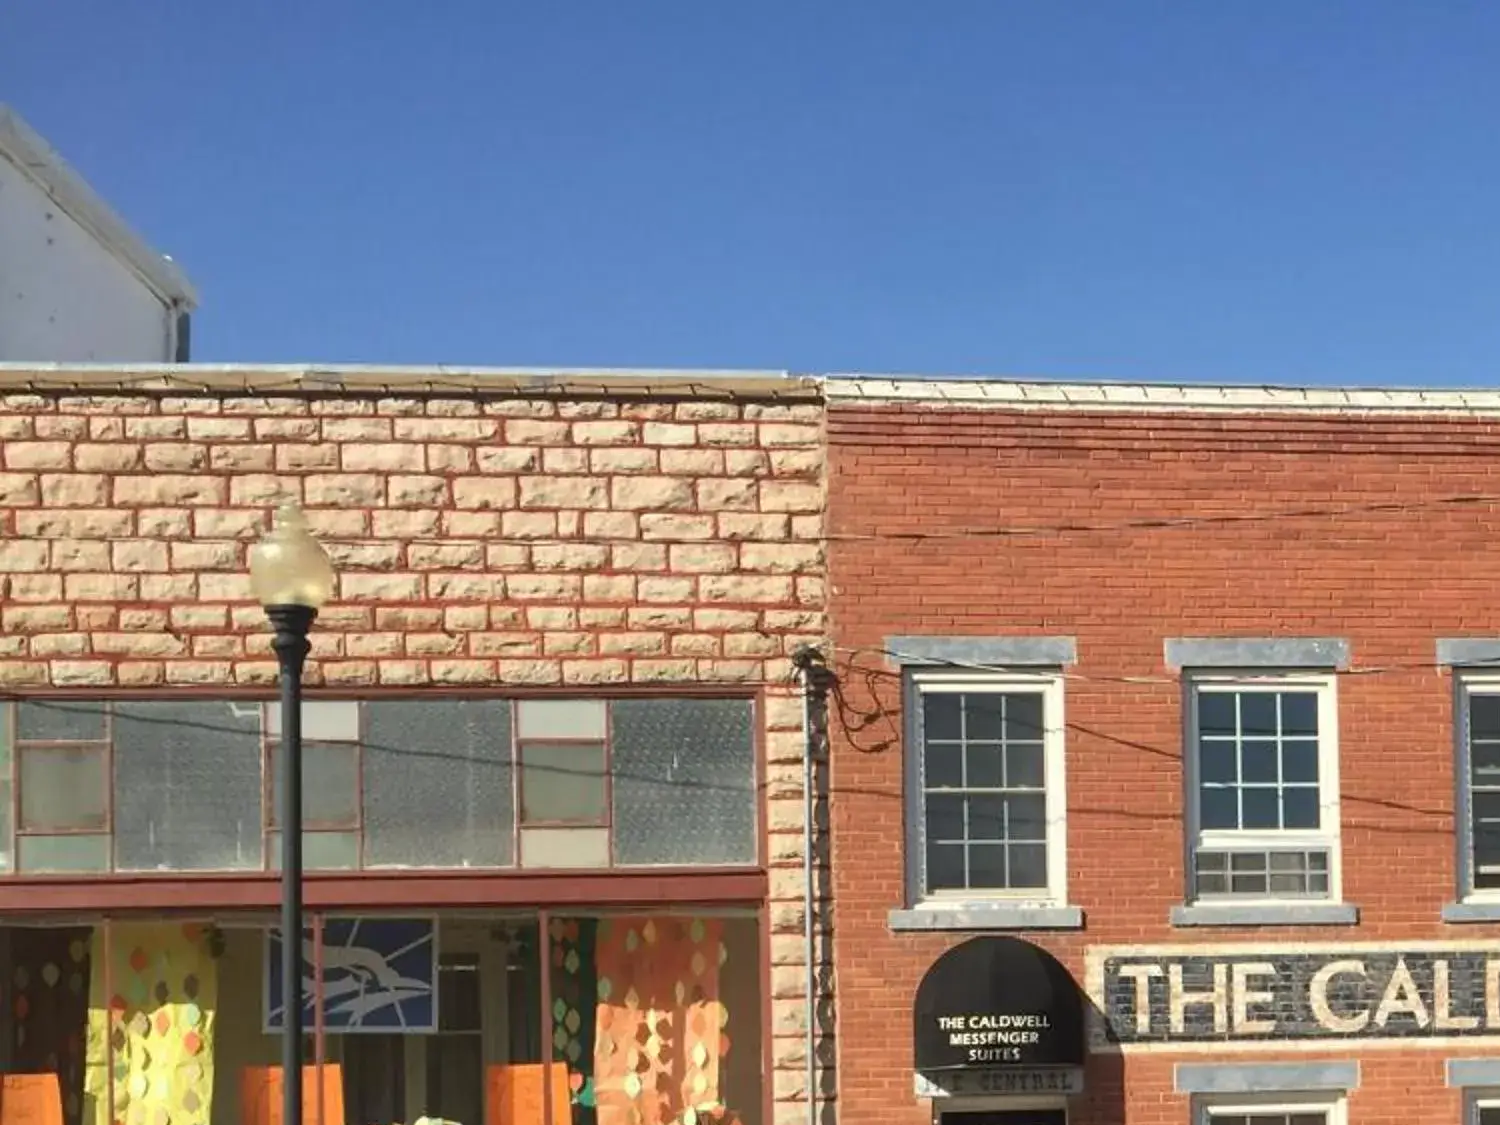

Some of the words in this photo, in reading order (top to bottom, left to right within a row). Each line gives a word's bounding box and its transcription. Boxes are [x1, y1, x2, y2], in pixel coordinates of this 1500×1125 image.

[1118, 960, 1278, 1035] THE
[938, 1015, 966, 1030] THE
[969, 1014, 1050, 1030] CALDWELL
[949, 1031, 1039, 1046] MESSENGER
[968, 1047, 1021, 1061] SUITES
[978, 1070, 1073, 1092] CENTRAL
